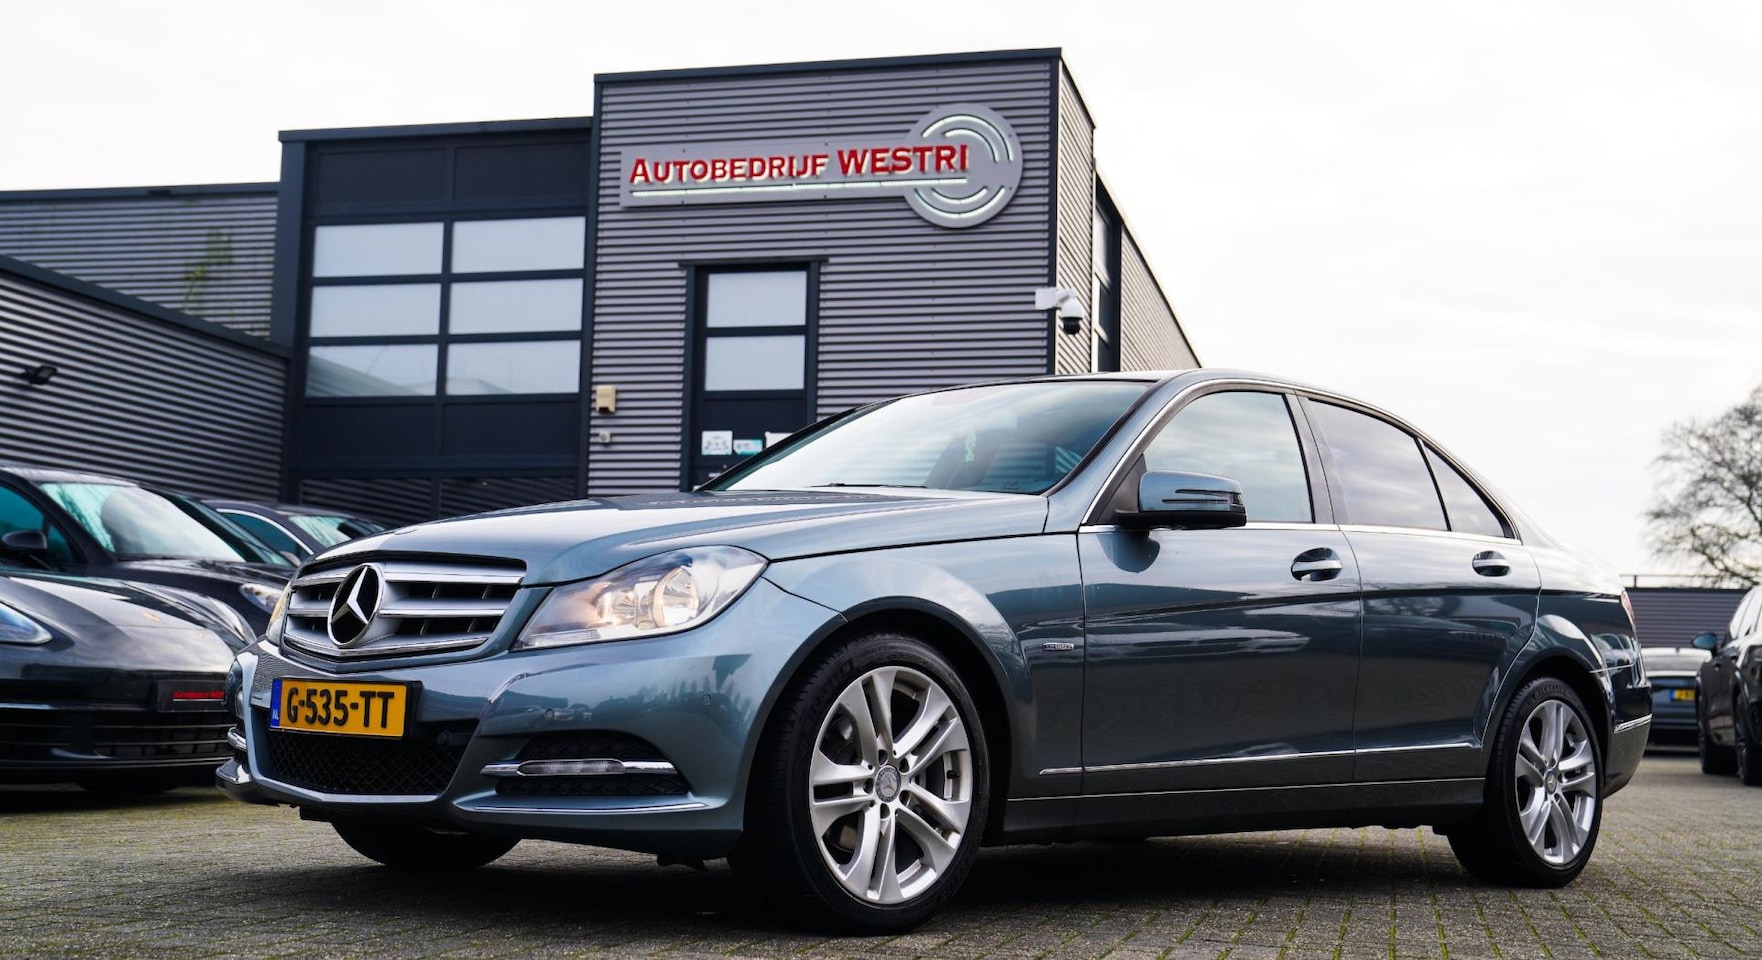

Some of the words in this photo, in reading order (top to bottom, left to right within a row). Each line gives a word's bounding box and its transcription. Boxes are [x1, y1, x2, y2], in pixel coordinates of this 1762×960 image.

[630, 154, 829, 184] AUTOBEDRIJF
[838, 145, 968, 175] WESTRI
[287, 687, 395, 728] G-535-TT
